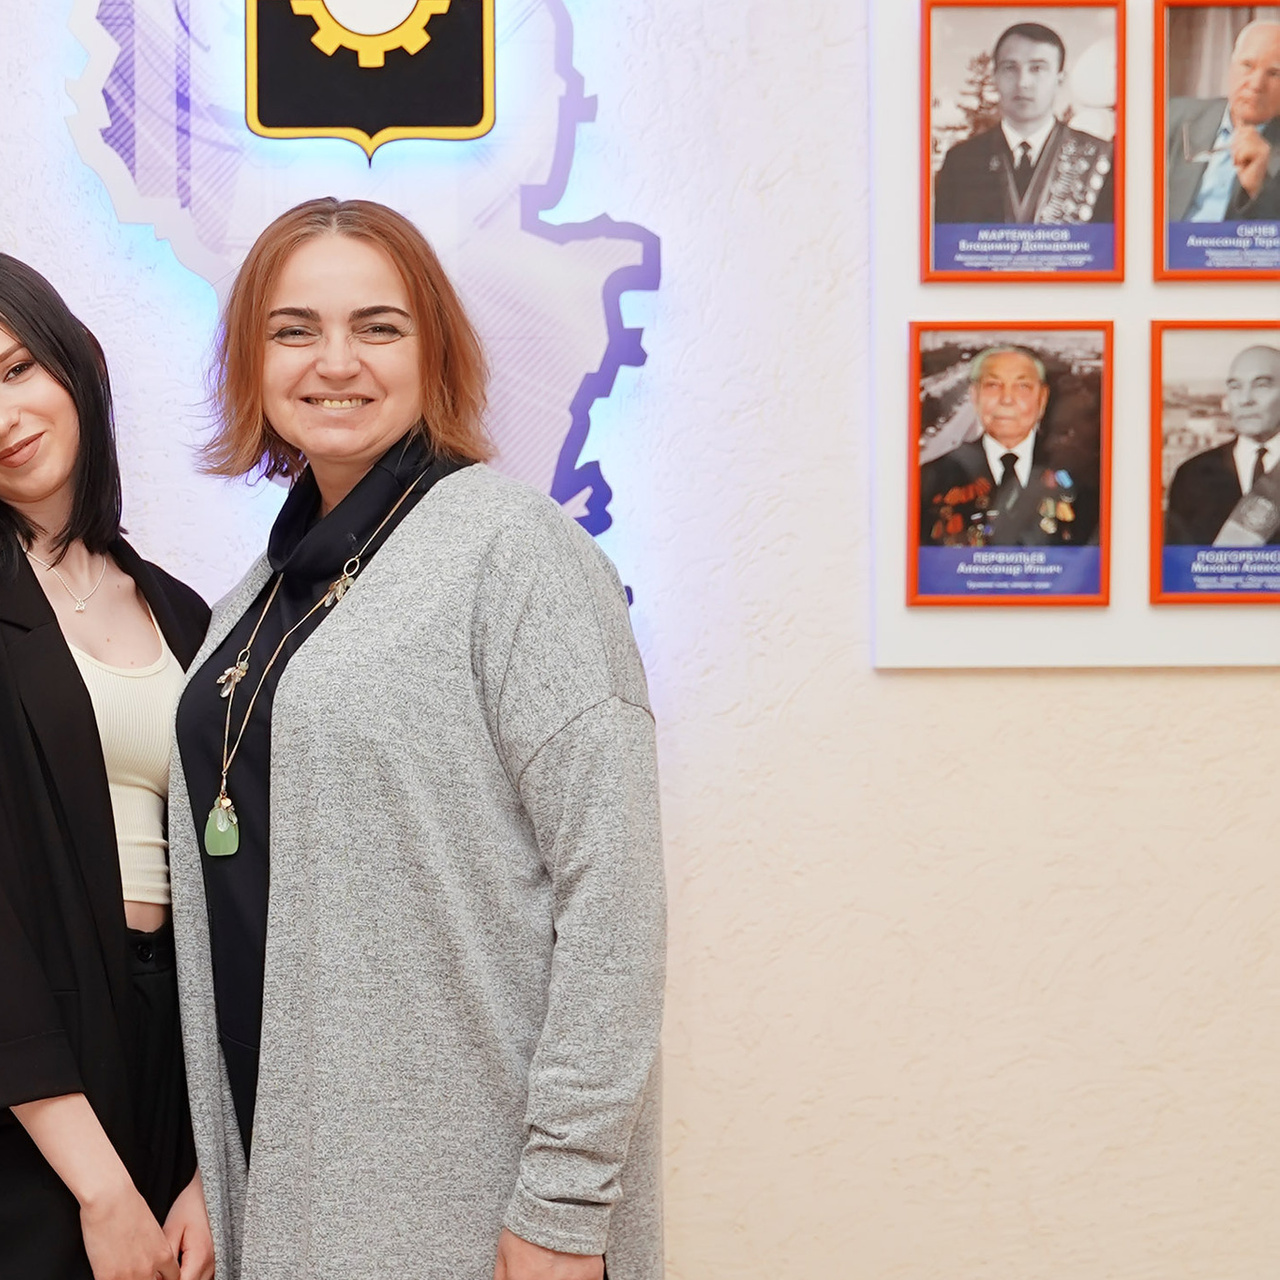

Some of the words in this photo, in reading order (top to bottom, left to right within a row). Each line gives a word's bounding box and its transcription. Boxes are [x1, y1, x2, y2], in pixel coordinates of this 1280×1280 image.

[977, 229, 1071, 242] МАРТЕМЬЯНОВ
[1236, 224, 1277, 237] СЫЧЕВ
[958, 240, 1019, 253] Владимир
[1021, 240, 1090, 252] Давыдович
[1186, 235, 1252, 250] Александр
[972, 551, 1047, 564] ПЕРФИЛЬЕВ
[956, 562, 1022, 576] Александр
[1023, 562, 1063, 574] Ильич
[1190, 561, 1238, 574] Михаил
